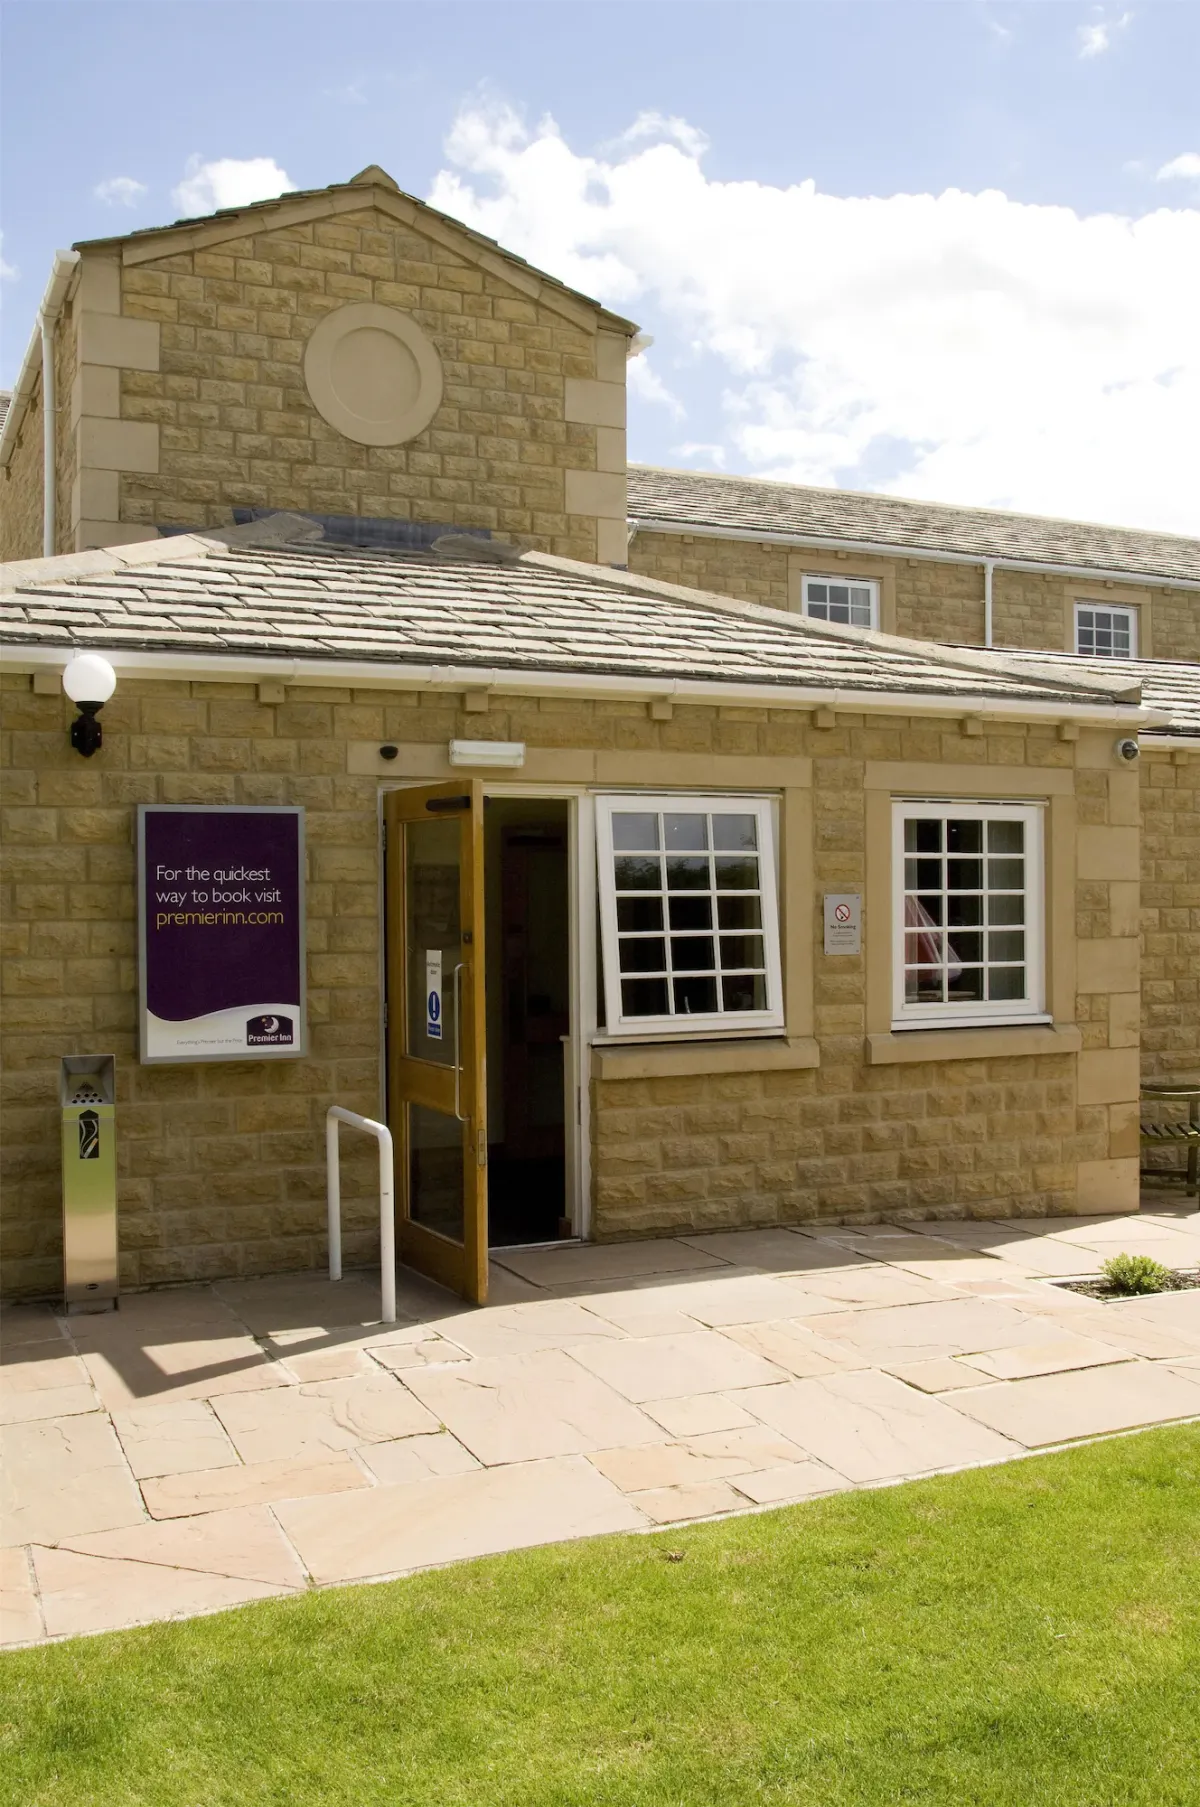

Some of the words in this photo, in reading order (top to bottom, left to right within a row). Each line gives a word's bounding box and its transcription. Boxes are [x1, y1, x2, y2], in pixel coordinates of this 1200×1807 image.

[156, 865, 182, 881] For
[185, 866, 210, 881] the
[213, 866, 271, 884] quickest
[156, 891, 187, 907] way
[191, 890, 209, 903] to
[212, 888, 252, 903] book
[255, 888, 282, 903] visit
[156, 908, 284, 930] premierinn.com
[248, 1033, 278, 1043] Premier
[279, 1033, 292, 1041] Inn
